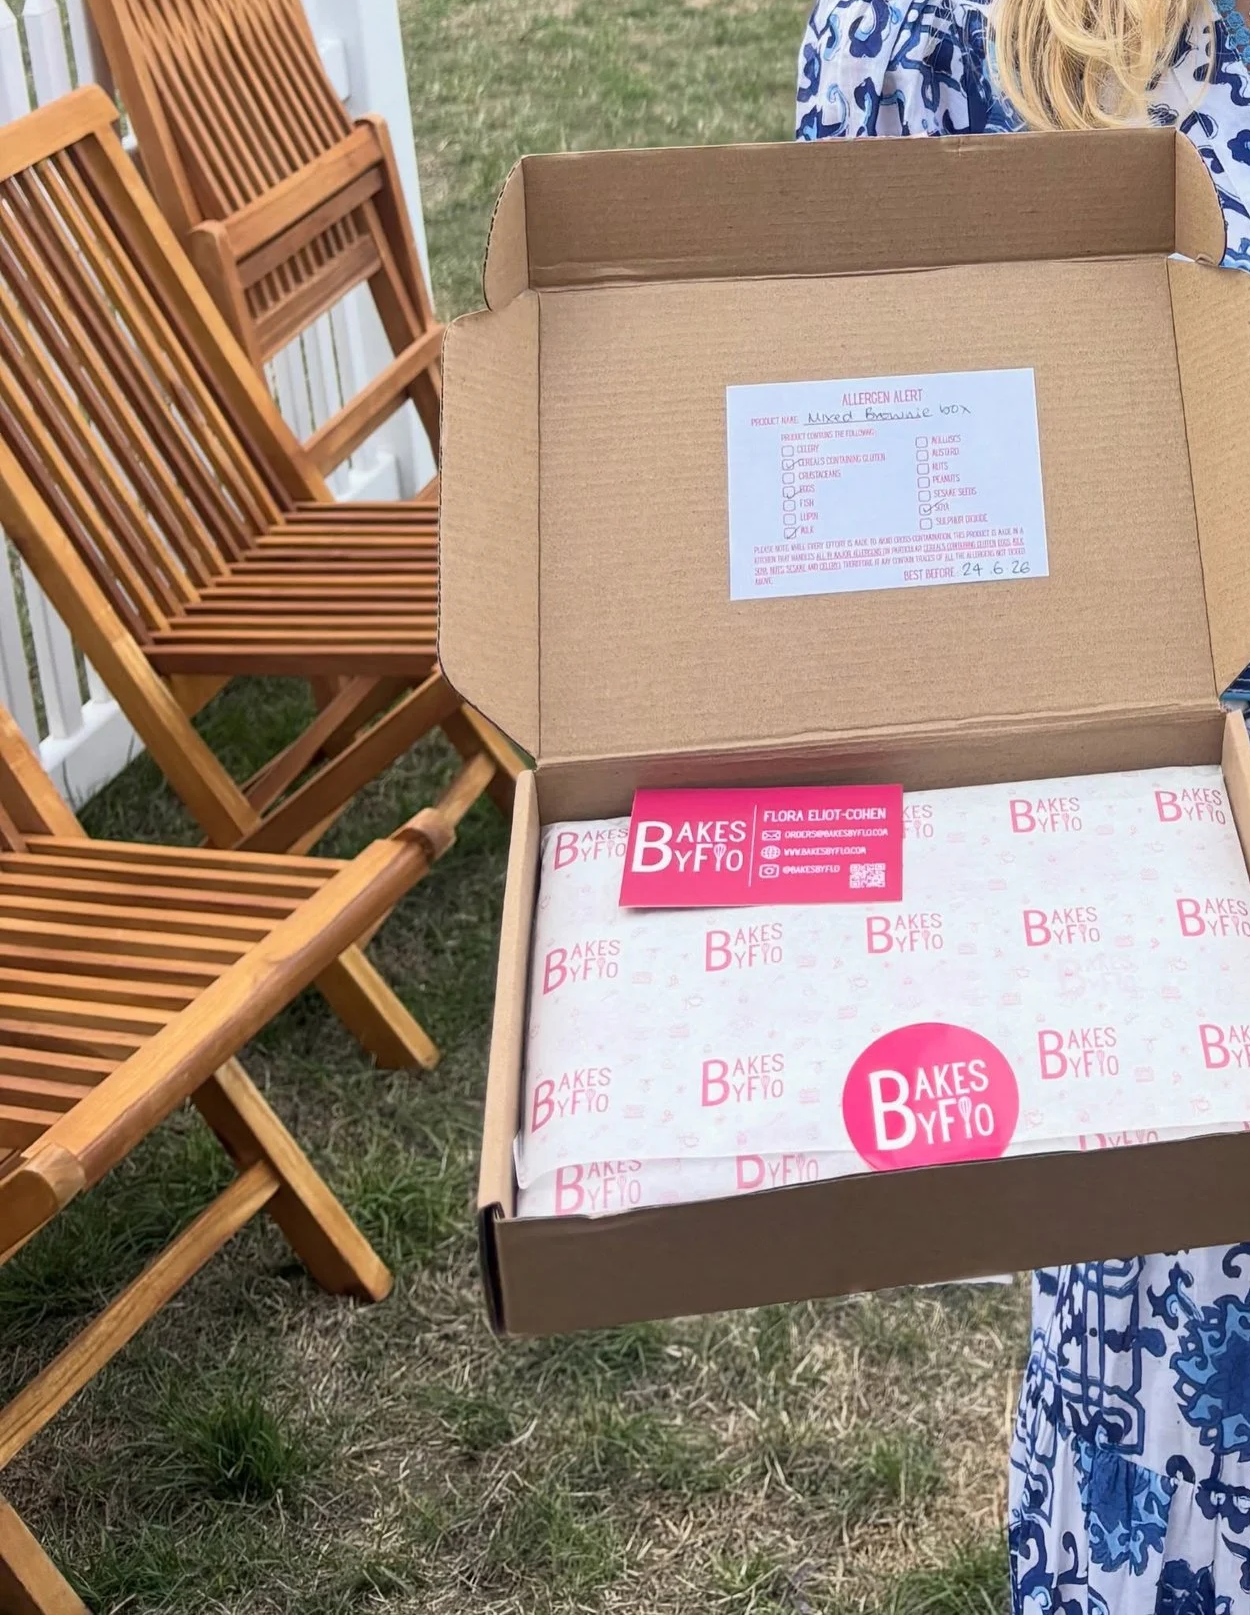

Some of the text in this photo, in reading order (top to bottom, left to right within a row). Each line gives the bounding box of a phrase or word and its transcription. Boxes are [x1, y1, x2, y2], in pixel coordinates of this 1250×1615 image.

[842, 388, 923, 406] ALLERGEN ALERT
[751, 417, 779, 426] PRODUCT
[808, 411, 852, 423] Mixed
[865, 406, 933, 421] Brownie
[800, 499, 814, 507] FISH
[904, 570, 922, 581] BEST
[763, 807, 886, 822] FLORA ELIOT-COHEN
[631, 819, 747, 873] BAKES
[868, 1059, 989, 1152] BAKES
